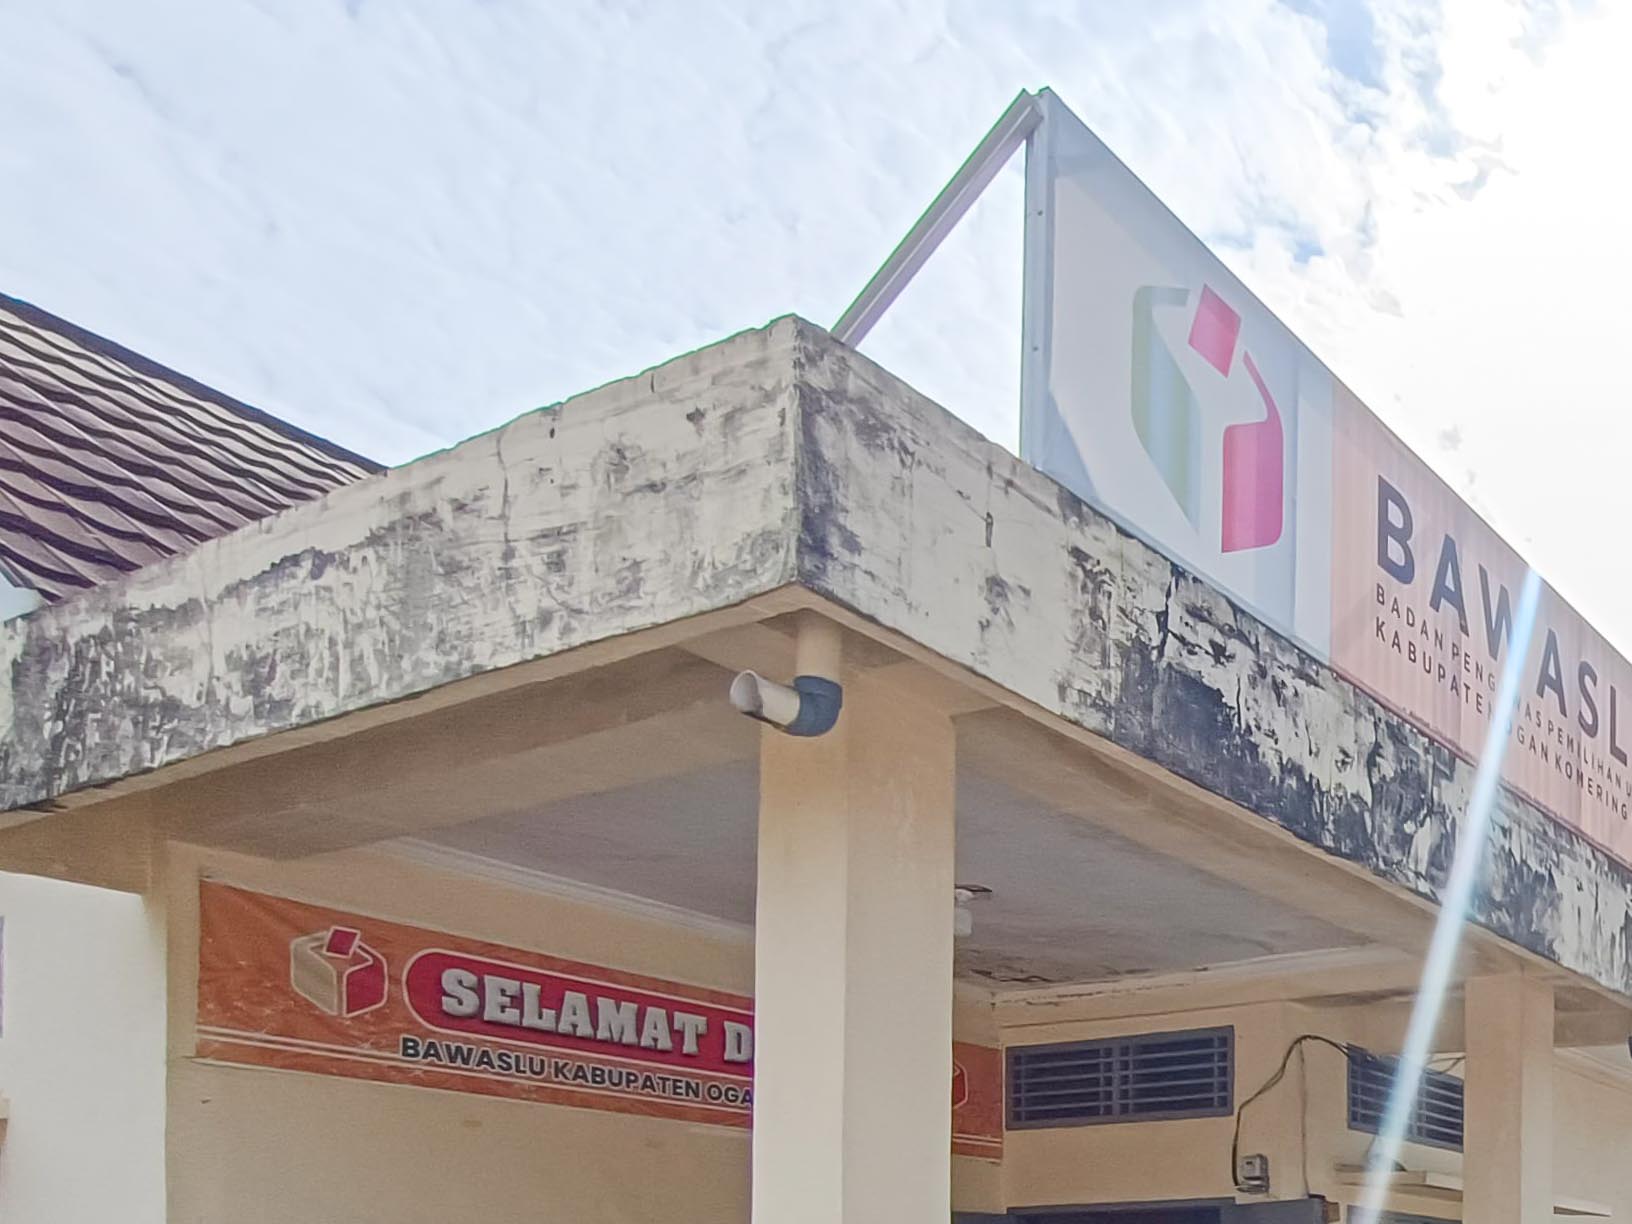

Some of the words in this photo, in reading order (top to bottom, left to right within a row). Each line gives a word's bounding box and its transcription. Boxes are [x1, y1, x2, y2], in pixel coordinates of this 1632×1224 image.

[1376, 582, 1443, 651] BADAN
[1452, 641, 1541, 729] PENGAS
[1548, 719, 1622, 788] PEMILIHAN
[1555, 752, 1628, 820] KOMERING
[441, 968, 708, 1055] SELAMAT
[401, 1036, 546, 1076] BAWASLU
[554, 1060, 700, 1100] KABUPATEN
[707, 1083, 753, 1106] OGA
